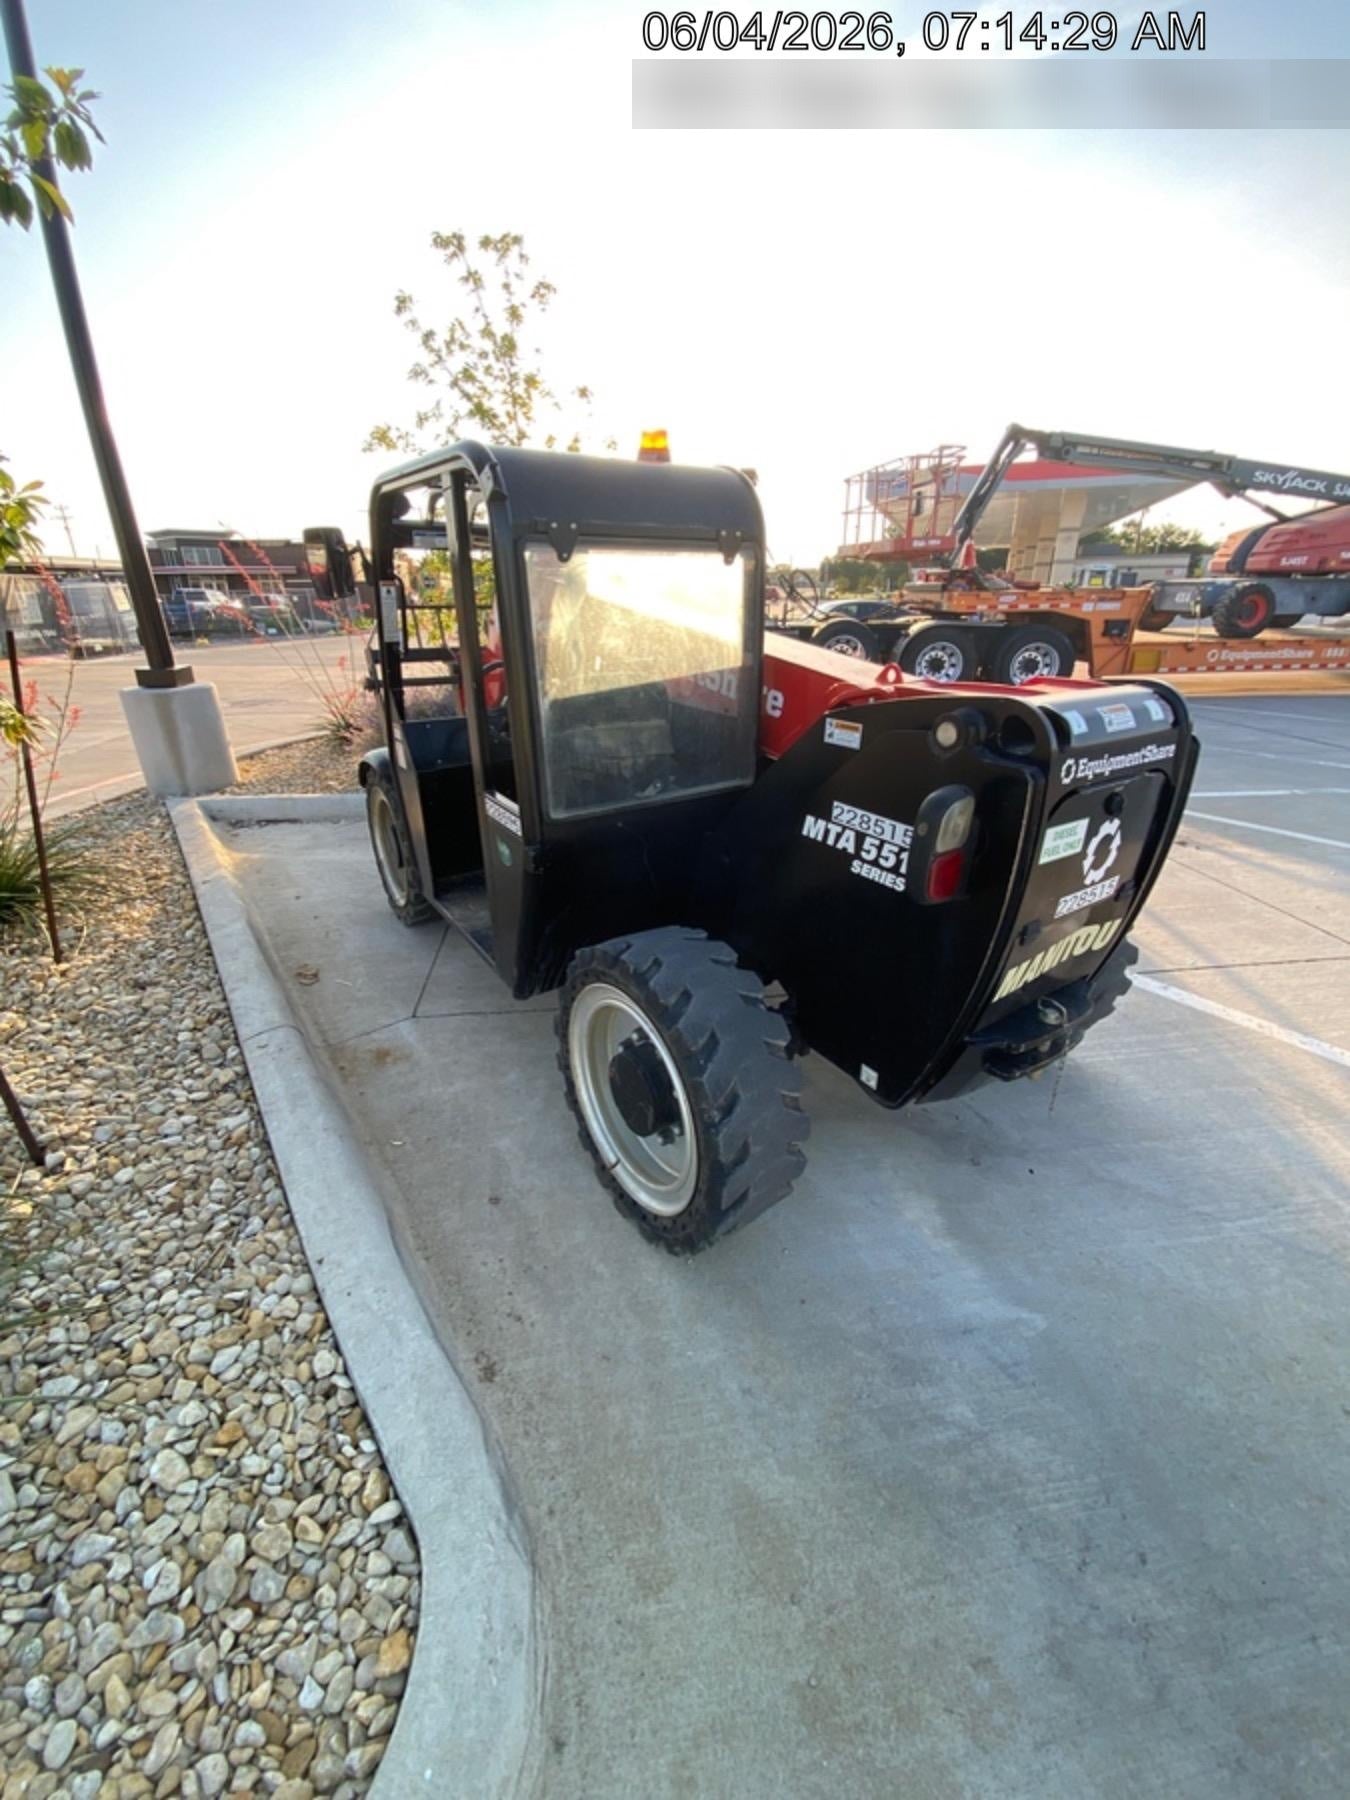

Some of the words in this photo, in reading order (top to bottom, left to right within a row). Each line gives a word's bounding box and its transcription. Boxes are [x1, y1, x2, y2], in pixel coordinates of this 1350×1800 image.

[1252, 470, 1328, 493] SKYJACK
[1220, 648, 1314, 662] EquipmentShare
[1076, 743, 1176, 780] EquipmentShare
[801, 813, 857, 855] MTA
[860, 835, 910, 875] 551
[850, 859, 907, 892] SERIES
[992, 918, 1122, 1003] MANITOU
